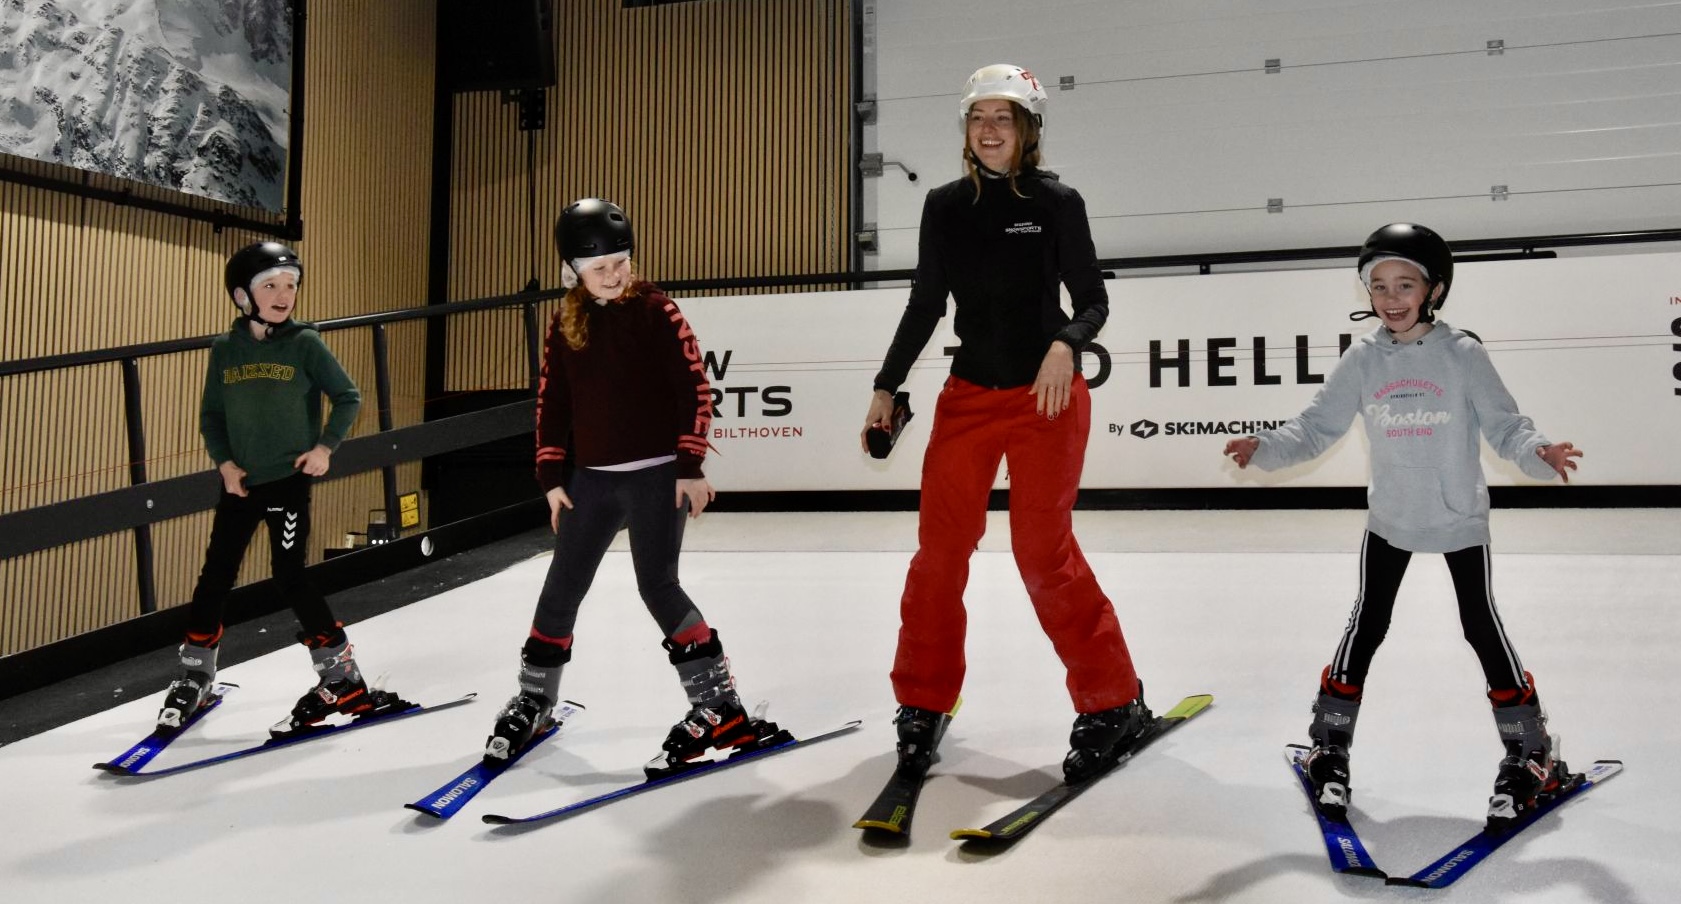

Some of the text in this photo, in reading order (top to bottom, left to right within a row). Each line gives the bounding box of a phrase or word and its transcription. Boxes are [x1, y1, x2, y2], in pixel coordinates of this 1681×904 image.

[1373, 378, 1445, 400] MASSACHUSETTS
[709, 385, 793, 418] RTS
[1365, 404, 1451, 426] Boston
[713, 426, 803, 439] BILTHOVEN
[1108, 423, 1124, 436] By
[1386, 427, 1433, 438] SOUTH END
[431, 777, 478, 810] SALOMON
